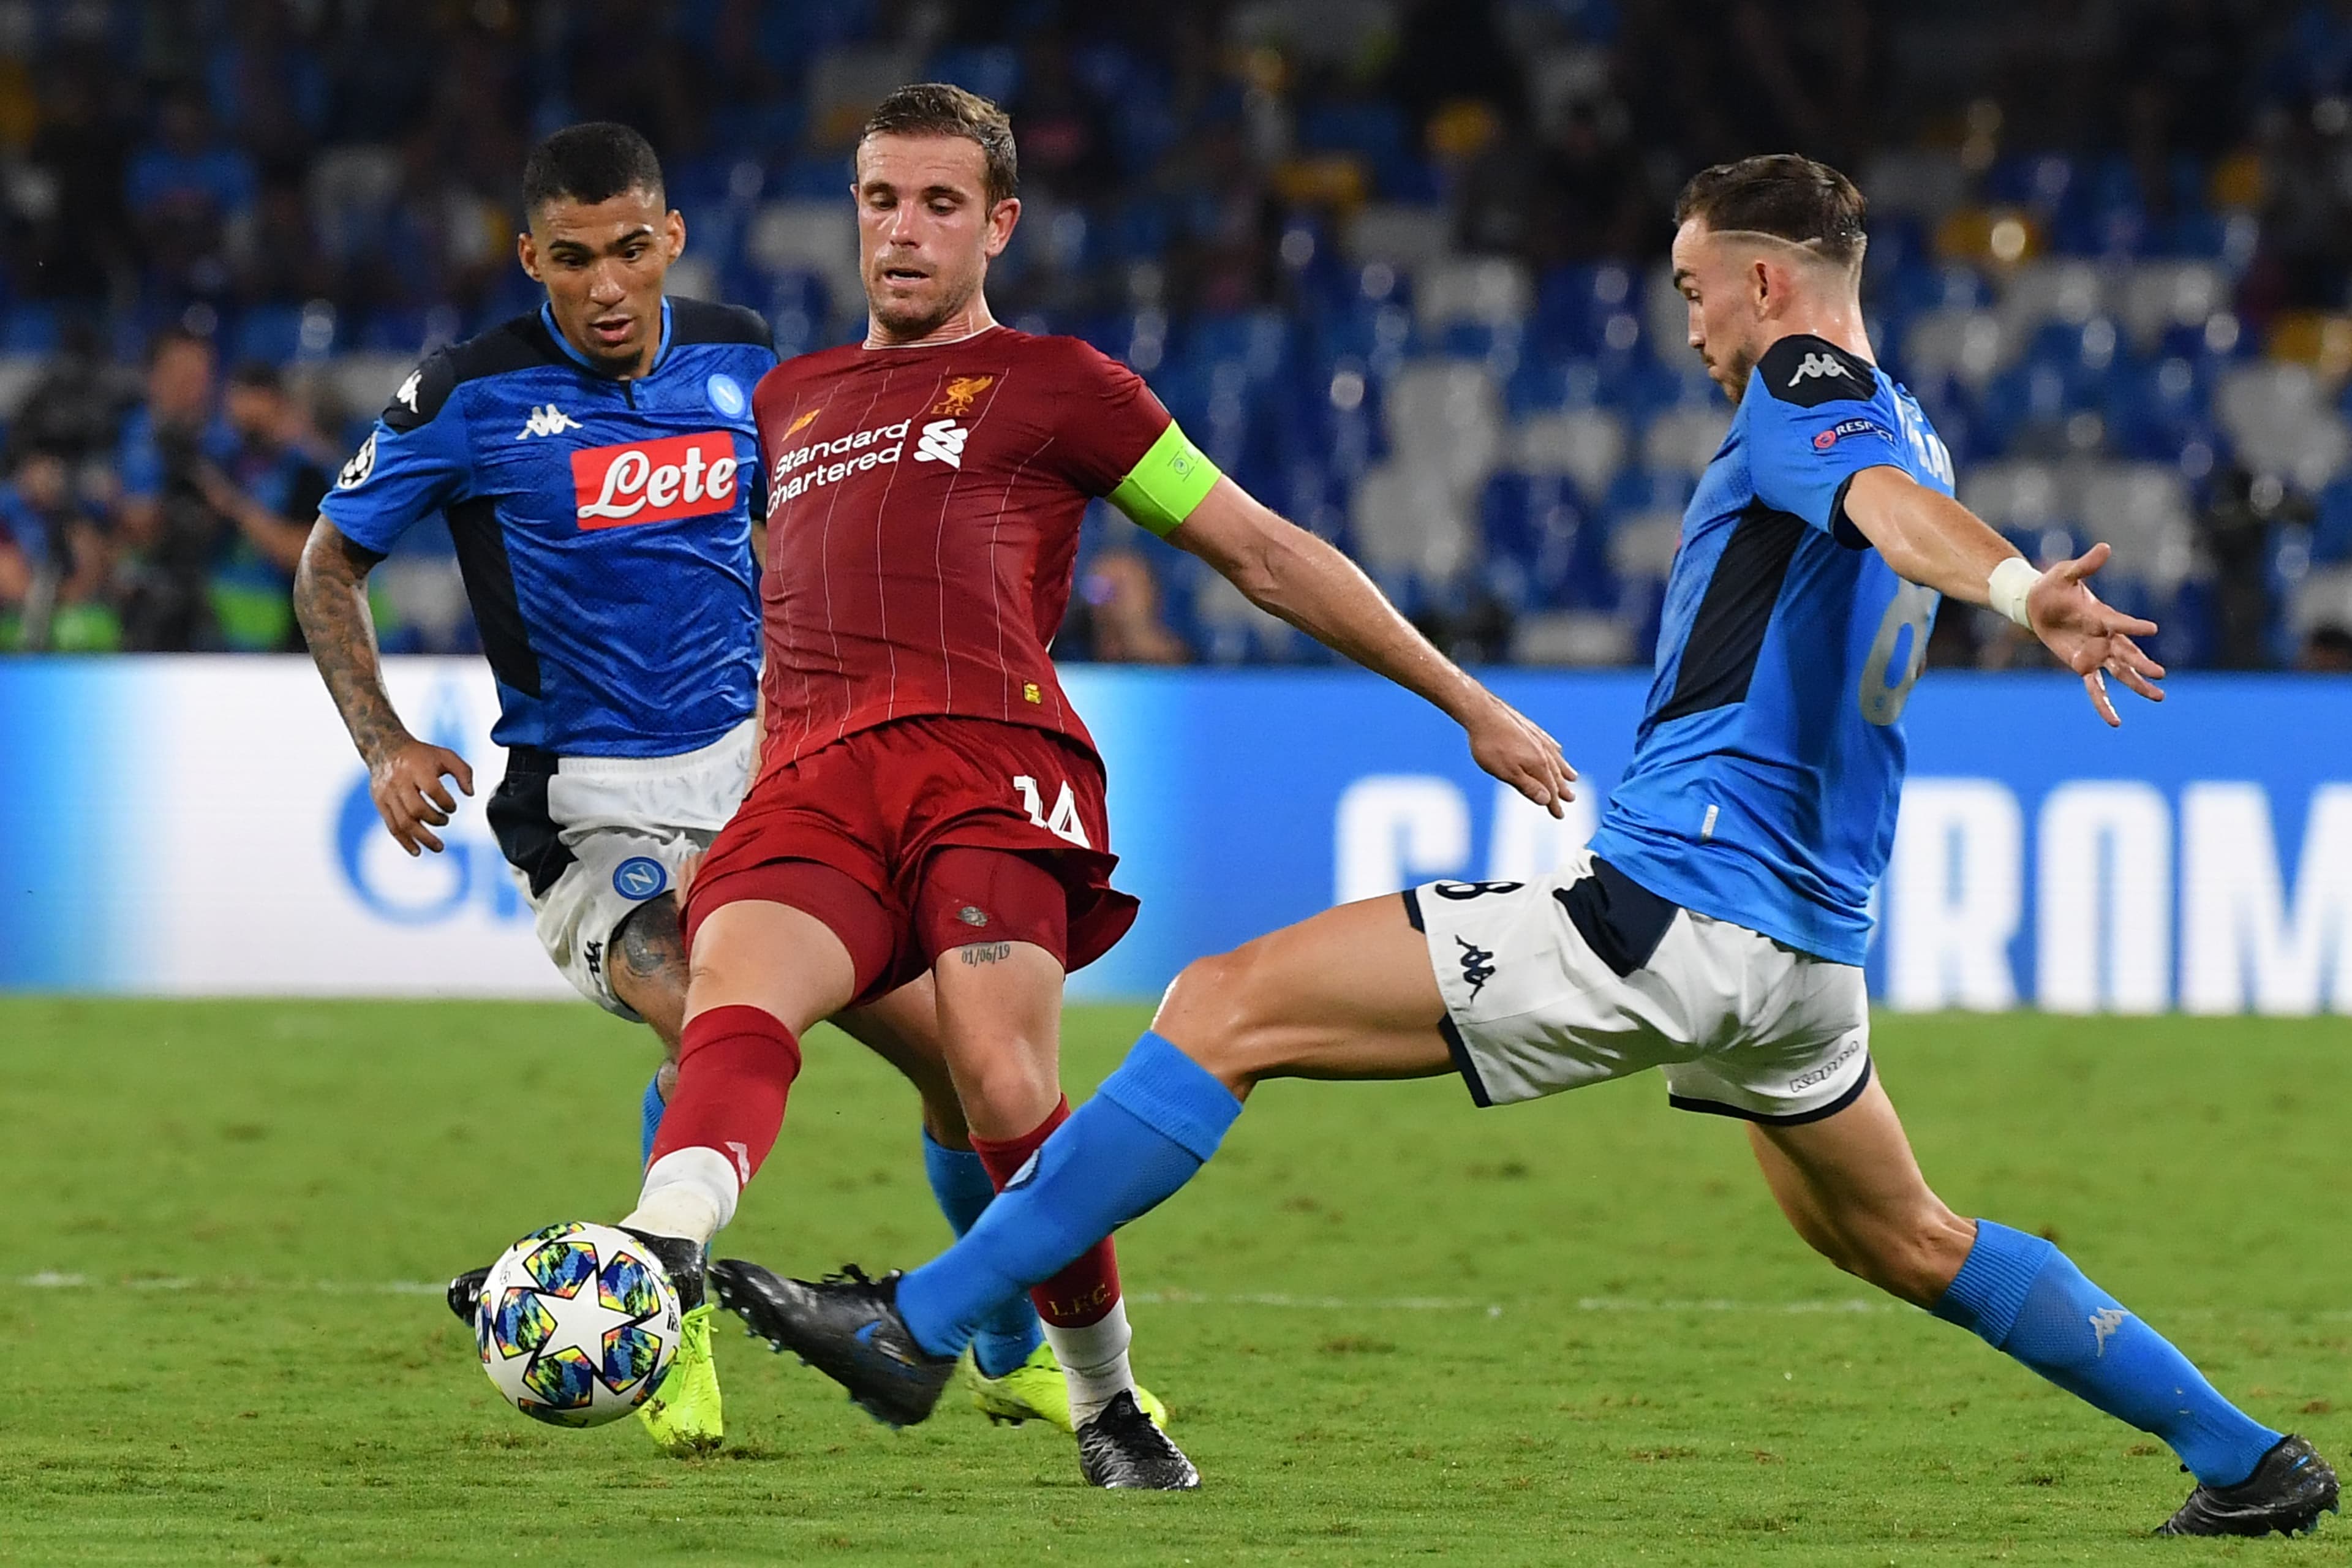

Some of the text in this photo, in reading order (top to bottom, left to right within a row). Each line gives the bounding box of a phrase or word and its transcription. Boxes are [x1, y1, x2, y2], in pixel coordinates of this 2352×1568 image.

[774, 418, 911, 483] Standard
[1836, 420, 1894, 442] RESPCT
[577, 447, 737, 519] Lete
[766, 442, 903, 519] Chartered
[961, 943, 1011, 968] 01/06/19
